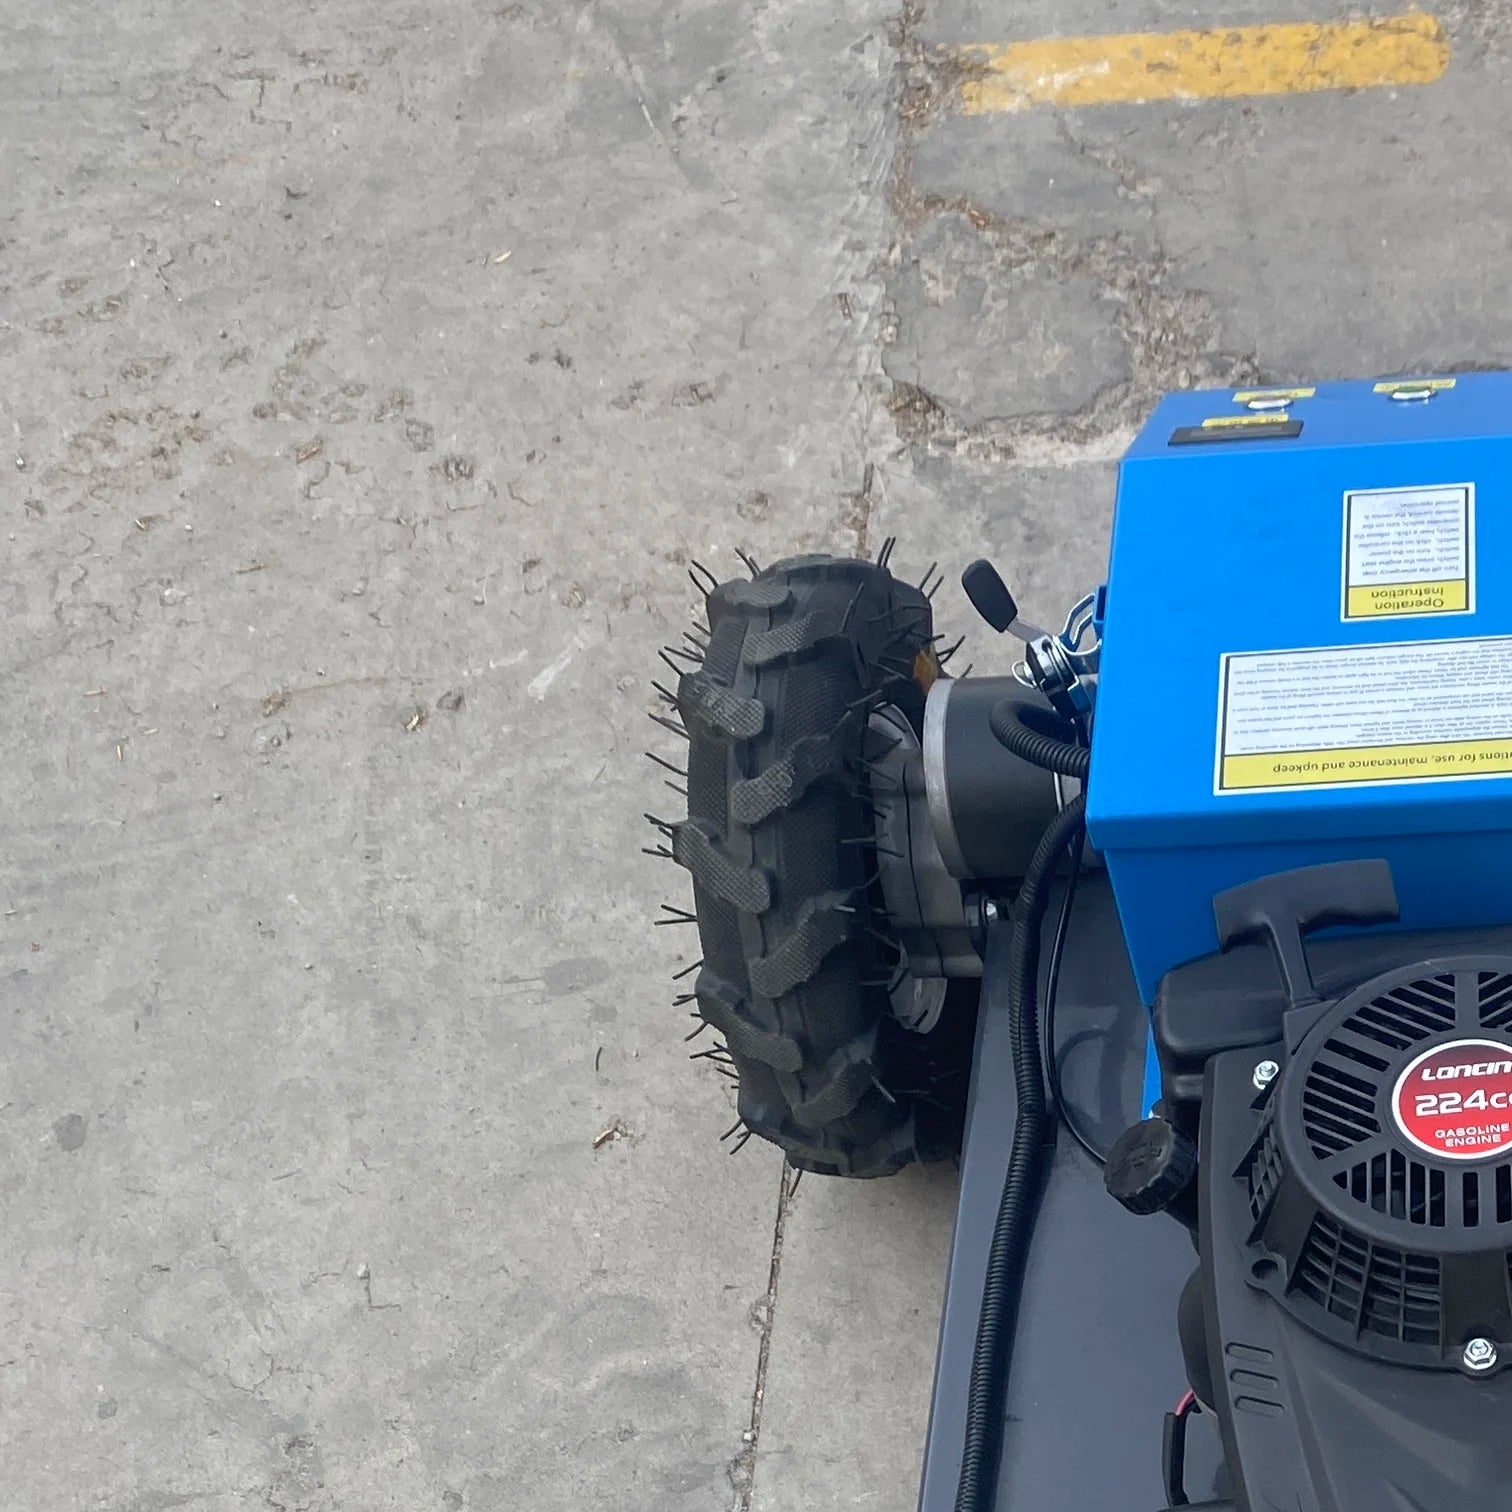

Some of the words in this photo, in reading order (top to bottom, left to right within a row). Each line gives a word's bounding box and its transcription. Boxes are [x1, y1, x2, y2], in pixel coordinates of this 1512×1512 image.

[1370, 586, 1443, 599] Instruction
[1374, 597, 1443, 611] Operation
[1349, 757, 1427, 769] maintenance
[1432, 755, 1455, 765] use,
[1459, 754, 1476, 763] for
[1273, 762, 1318, 774] upkeep
[1322, 762, 1345, 772] and
[1434, 1122, 1510, 1139] GASOLINE
[1445, 1133, 1501, 1148] ENGINE
